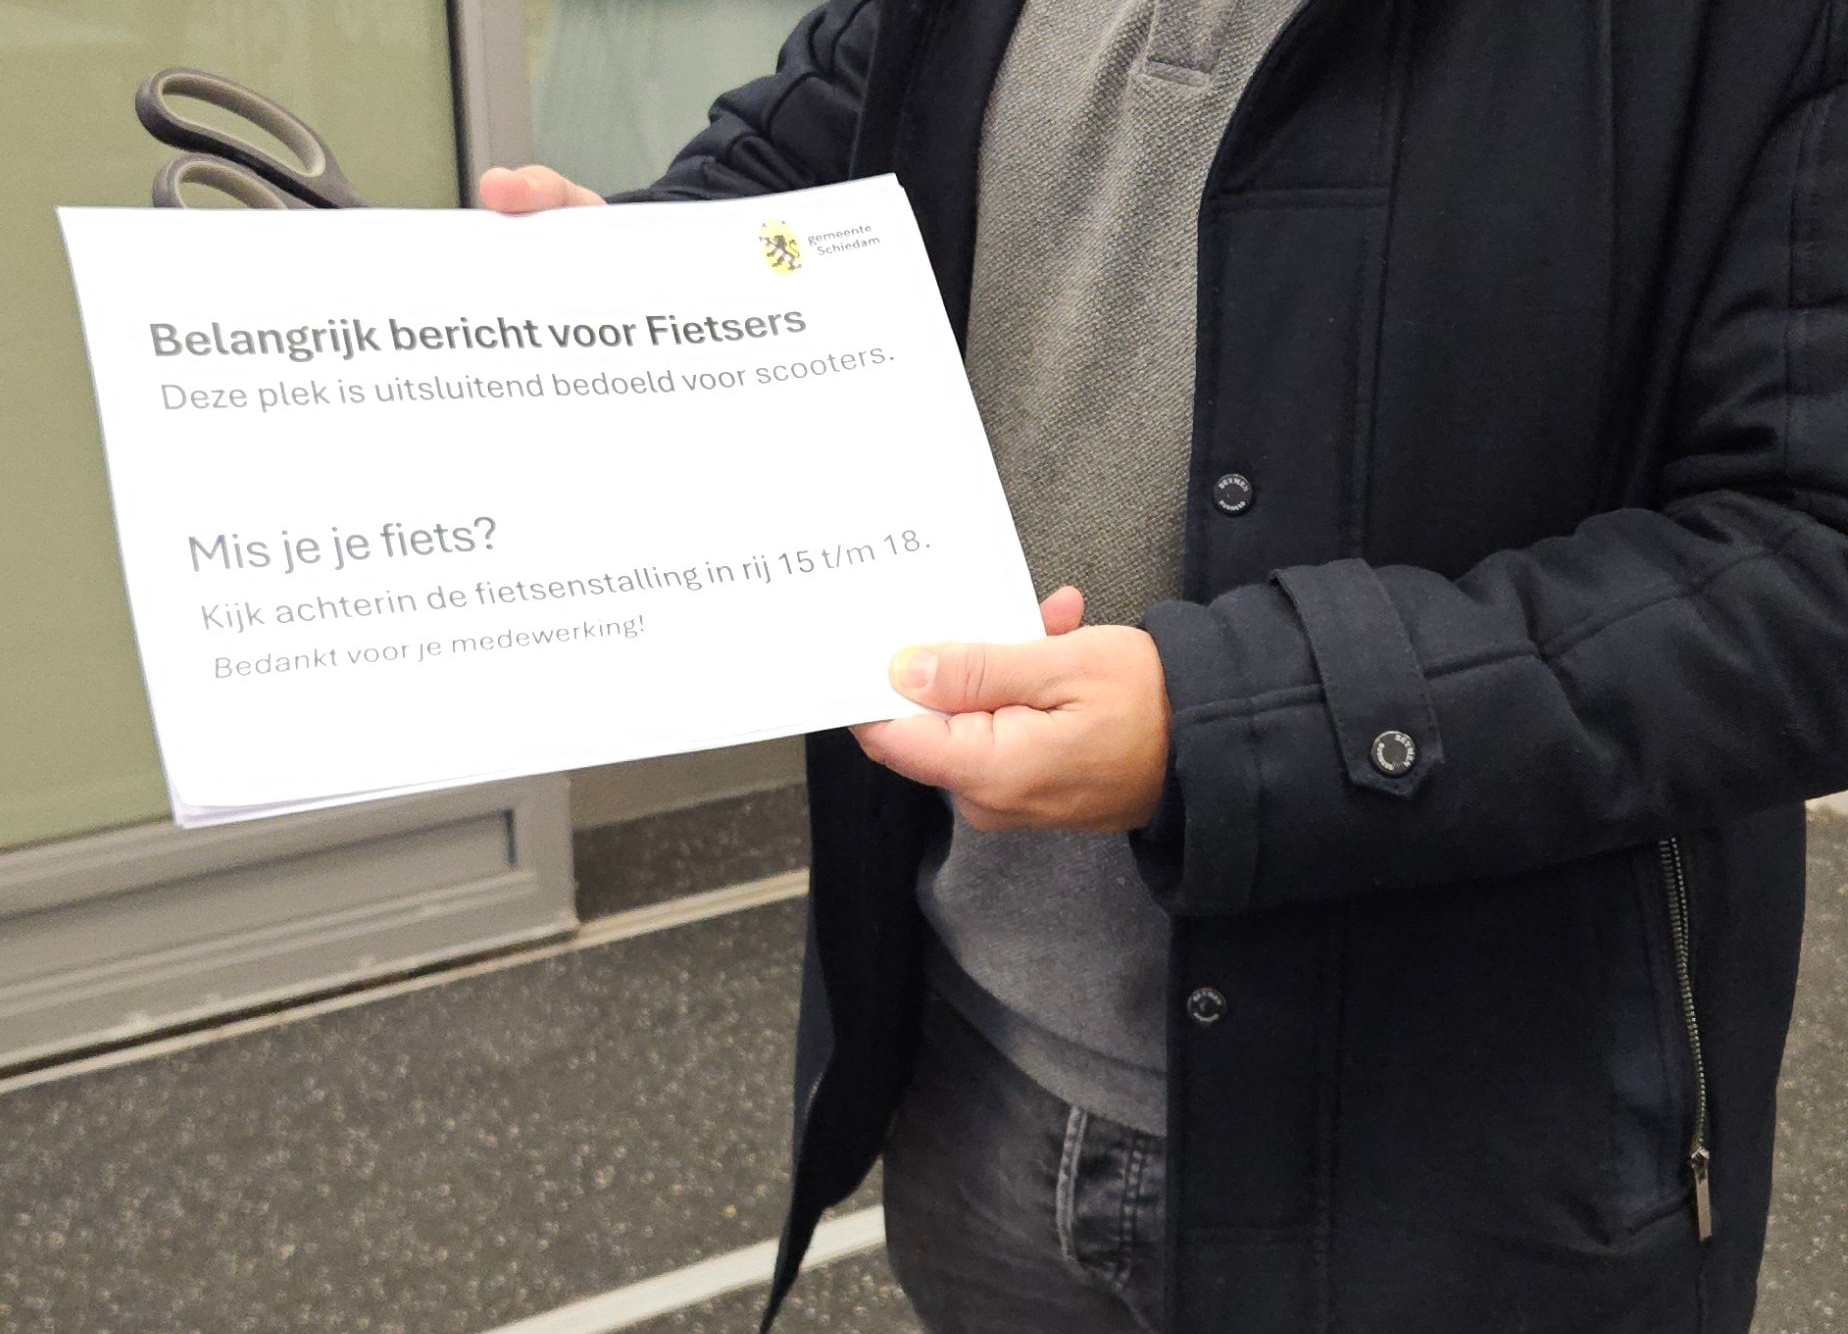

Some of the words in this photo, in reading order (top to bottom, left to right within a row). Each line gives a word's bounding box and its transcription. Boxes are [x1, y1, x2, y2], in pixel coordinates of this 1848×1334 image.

[807, 225, 872, 247] gemeente
[816, 233, 880, 255] Schiedam
[149, 319, 382, 362] Belangrijk
[391, 317, 542, 351] bericht
[547, 324, 637, 348] voor
[646, 311, 806, 346] Fietsers
[161, 385, 247, 409] Deze
[259, 380, 330, 413] plek
[338, 379, 365, 403] is
[375, 374, 544, 402] uitsluitend
[552, 370, 675, 396] bedoeld
[681, 370, 746, 391] voor
[756, 348, 894, 384] scooters.
[188, 534, 271, 572] Mis
[282, 530, 321, 574] je
[332, 527, 371, 570] je
[380, 517, 496, 557] fiets?
[202, 602, 265, 633] Kijk
[276, 590, 417, 623] achterin
[427, 586, 467, 609] de
[475, 567, 702, 604] fietsenstalling
[705, 562, 734, 583] in
[743, 555, 771, 584] rij
[778, 550, 814, 574] 15
[821, 545, 875, 568] t/m
[884, 530, 930, 555] 18.
[215, 649, 337, 678] Bedankt
[348, 645, 408, 664] voor
[417, 640, 442, 664] je
[453, 615, 643, 653] medewerking!
